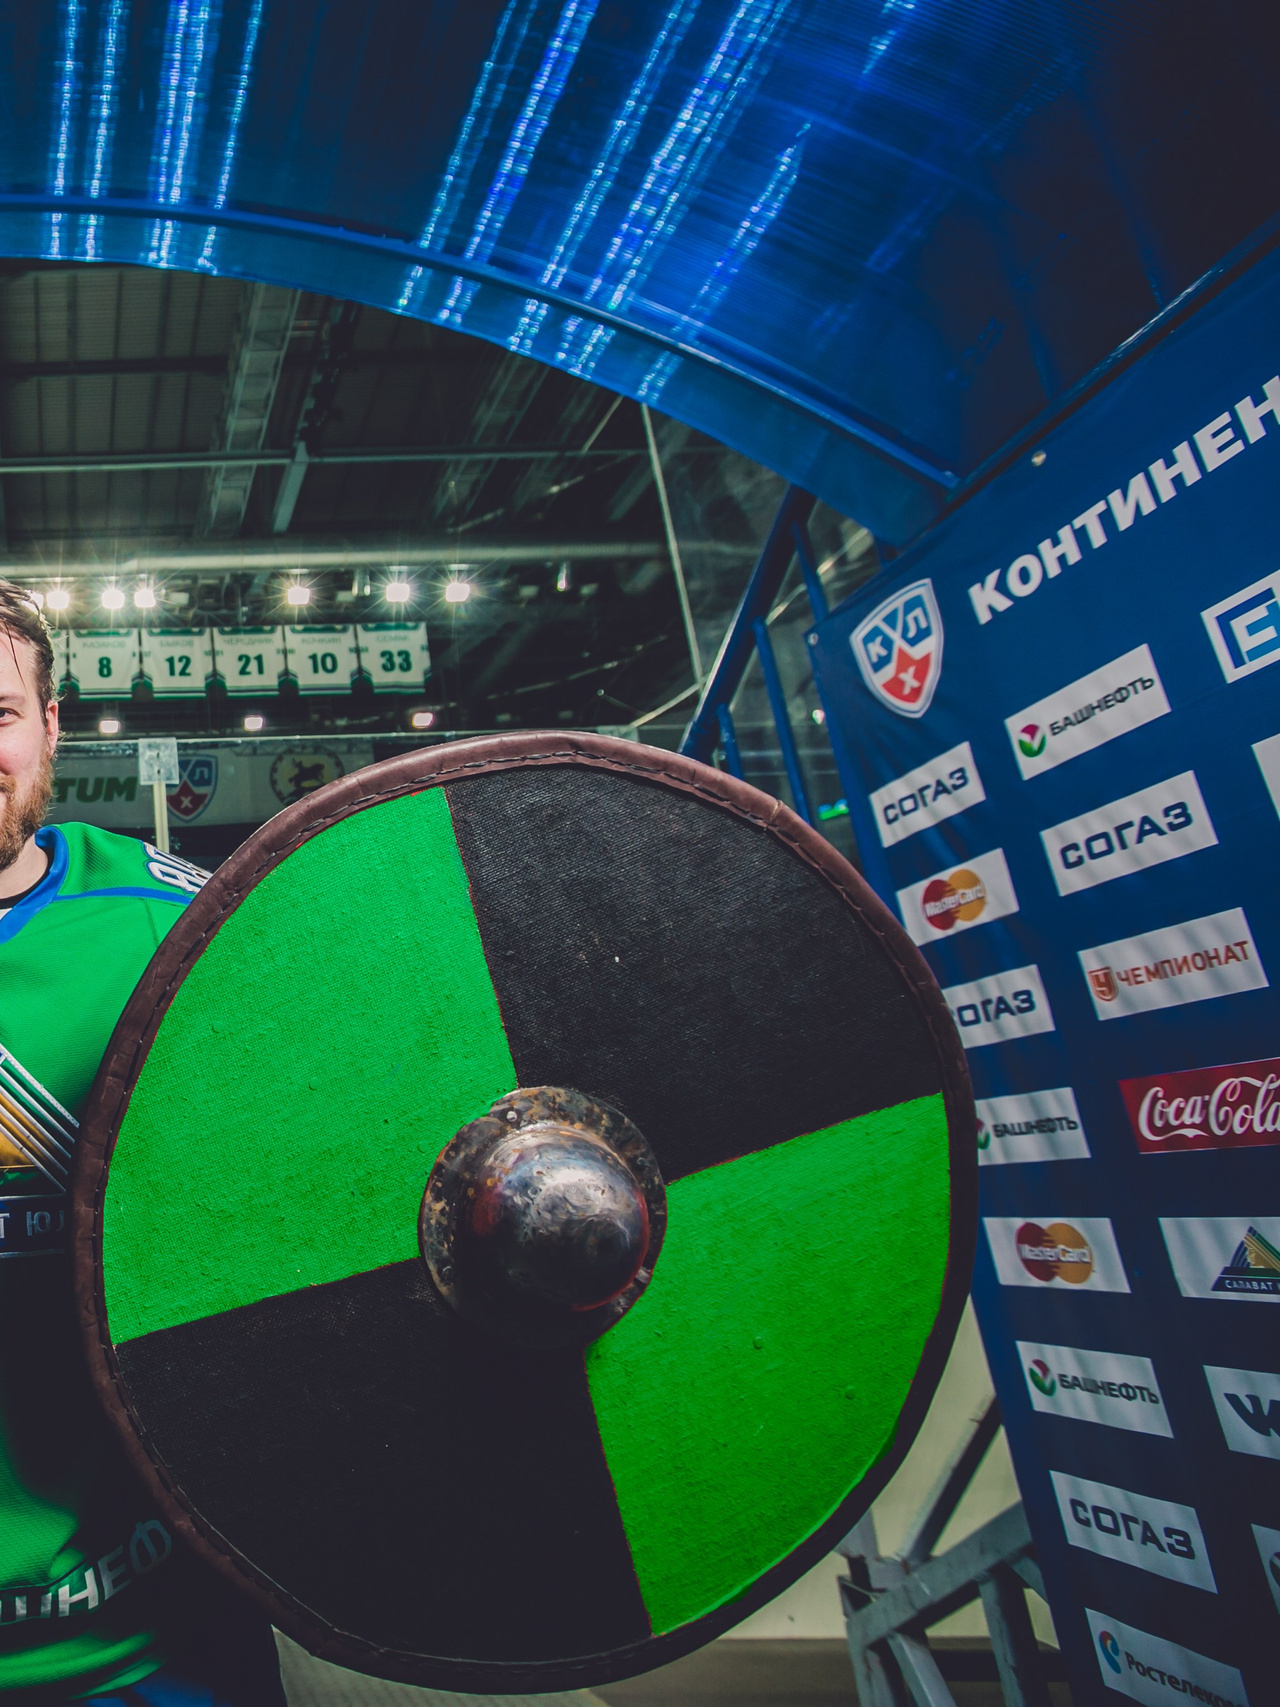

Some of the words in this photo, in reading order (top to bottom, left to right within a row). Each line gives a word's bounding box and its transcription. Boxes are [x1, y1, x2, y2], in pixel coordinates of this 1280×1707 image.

[98, 656, 112, 678] 8
[165, 655, 192, 676] 12
[238, 654, 264, 675] 21
[308, 652, 338, 674] 10
[380, 650, 412, 672] 33
[1049, 676, 1155, 737] БАШНЕФТЬ
[54, 776, 139, 802] TUM
[882, 765, 970, 826] СОГАЗ
[1058, 800, 1194, 870] СОГАЗ
[924, 884, 986, 917] MasterCard
[1116, 940, 1249, 988] ЧЕМПИОНАТ
[951, 989, 1036, 1027] ОГАЗ
[1138, 1073, 1280, 1138] Coca-Cola
[993, 1116, 1078, 1138] БАШНЕФТЬ
[1018, 1244, 1091, 1263] MasterCard
[1225, 1280, 1273, 1291] САЛАВАТ
[1059, 1372, 1160, 1405] БАШНЕФТЬ
[1069, 1497, 1196, 1561] СОГАЗ
[1125, 1651, 1244, 1707] Ростелеко
